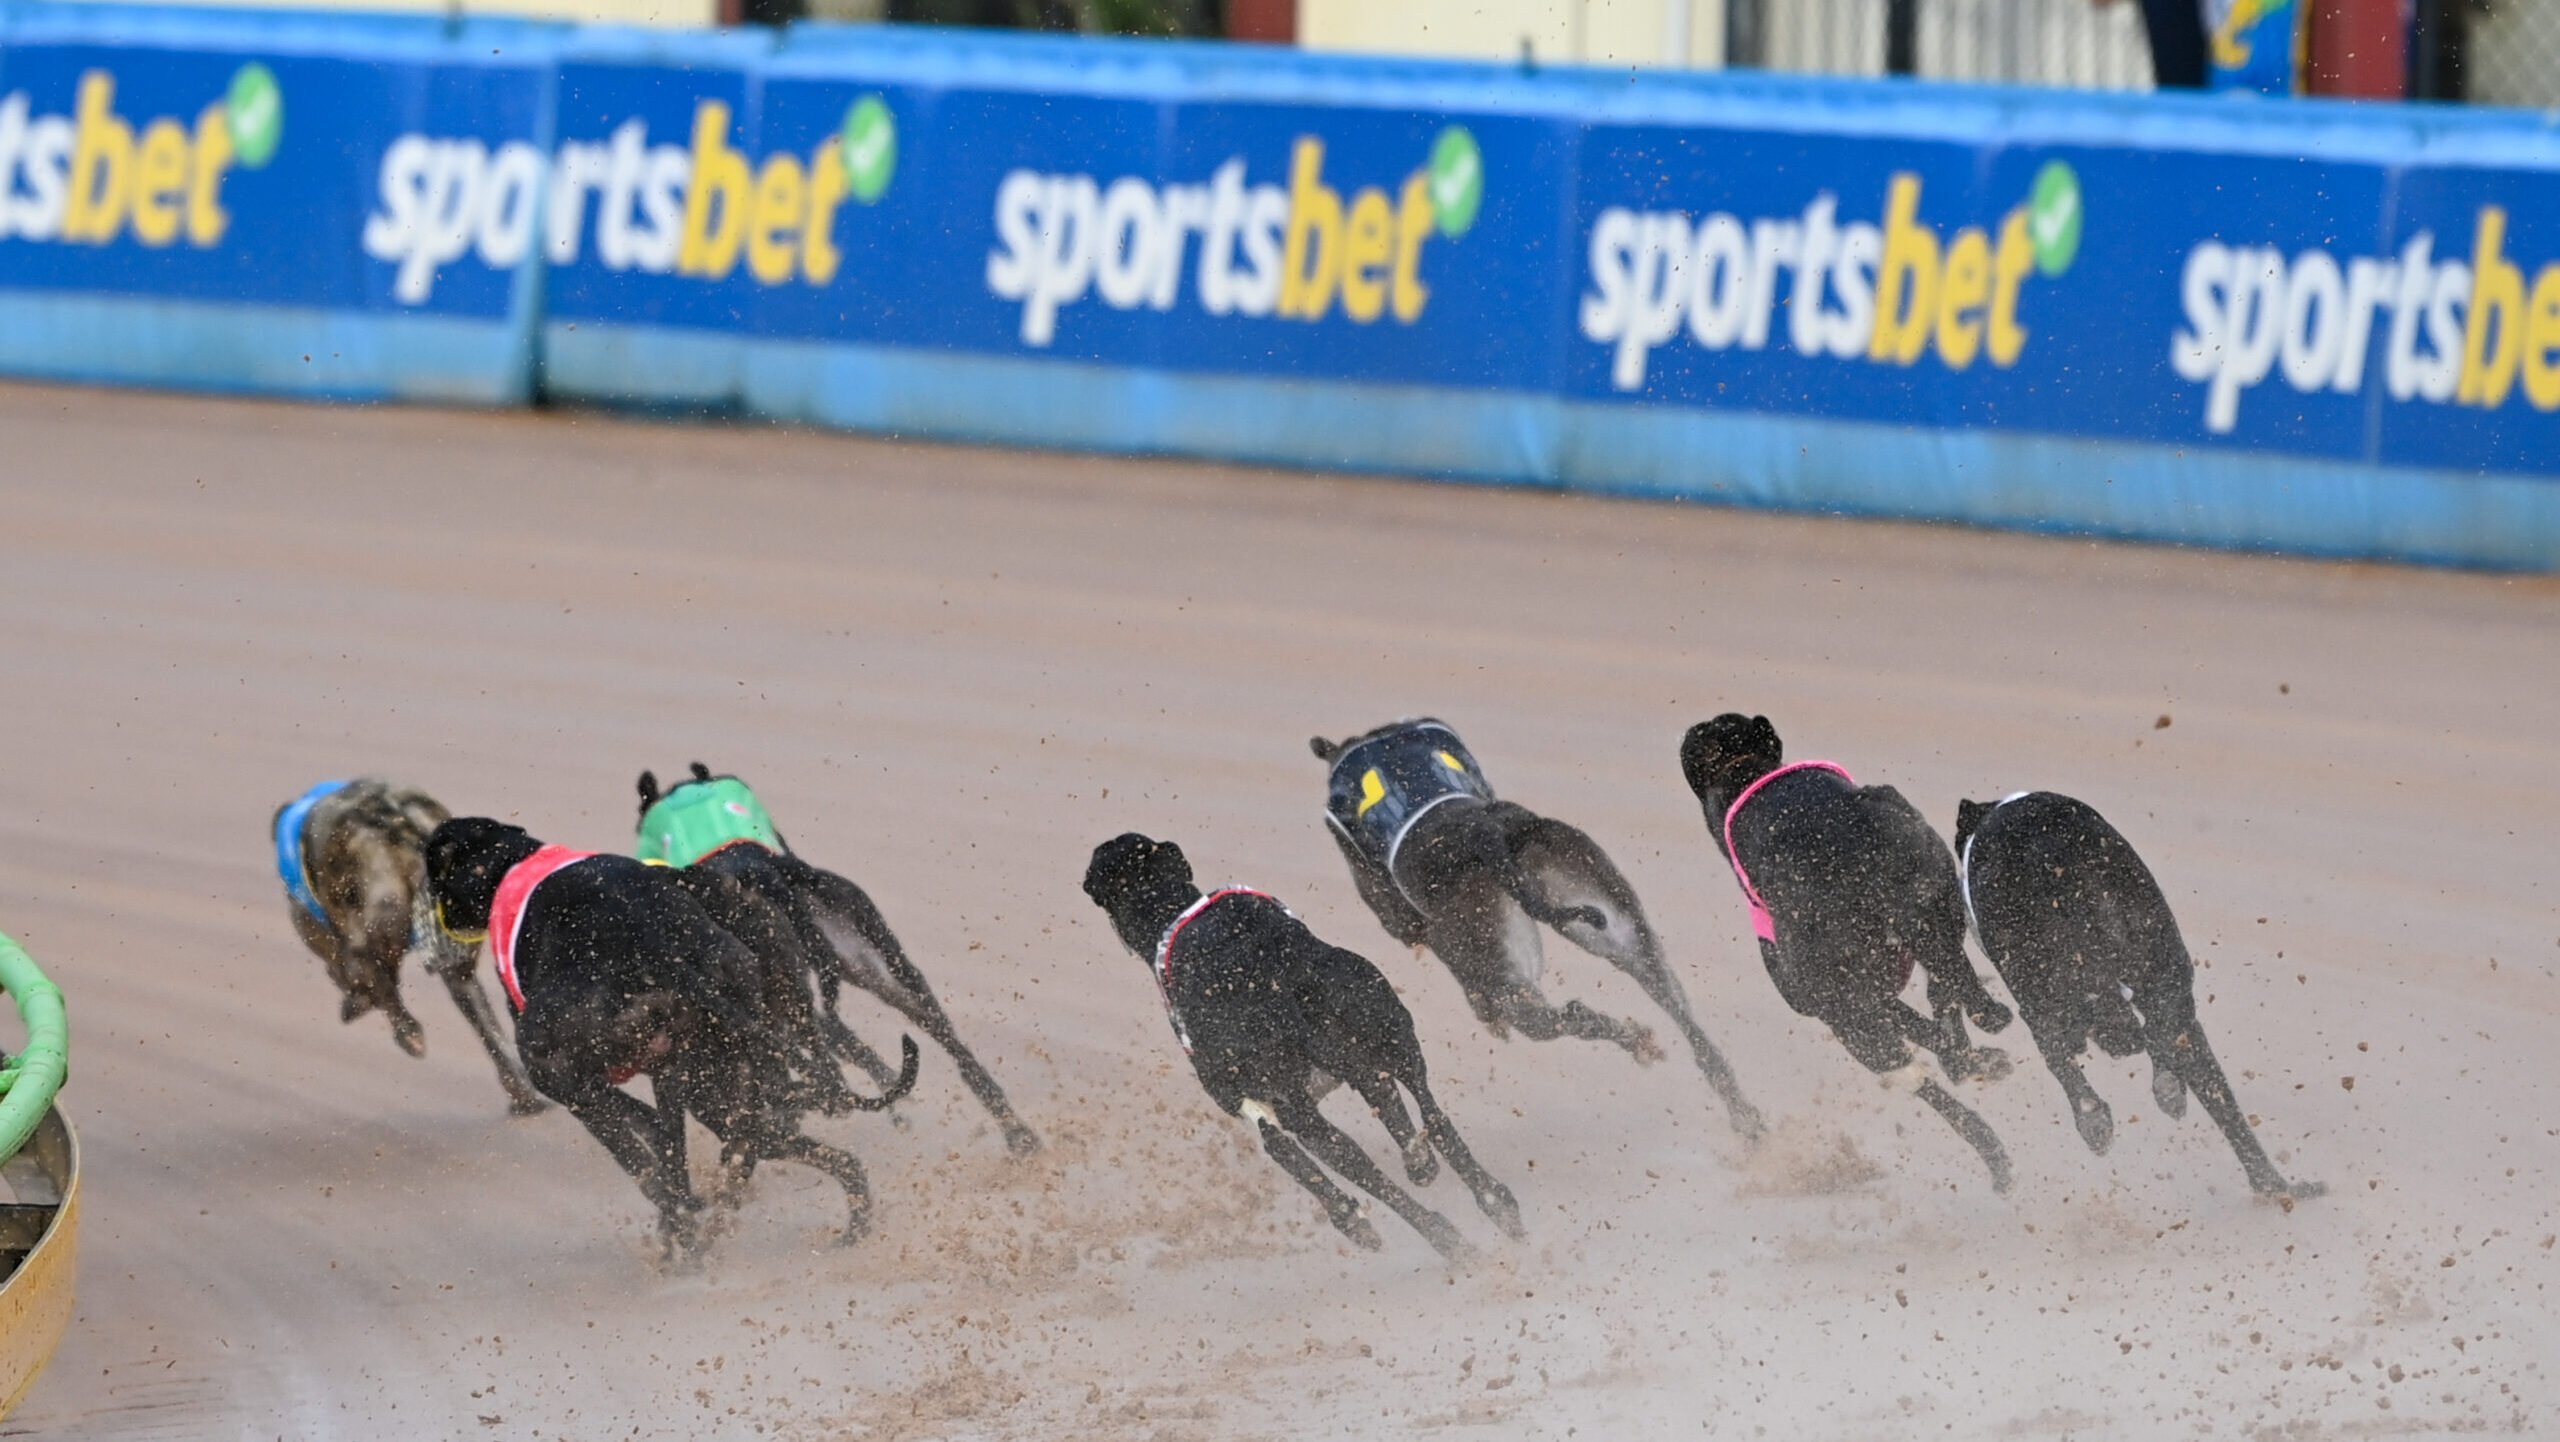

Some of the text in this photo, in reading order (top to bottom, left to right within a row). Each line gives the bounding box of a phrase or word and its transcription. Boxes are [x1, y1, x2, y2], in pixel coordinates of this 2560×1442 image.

[364, 100, 845, 304] sportsbet
[986, 135, 1436, 346] sportsbet
[1581, 173, 2034, 390] sportsbet
